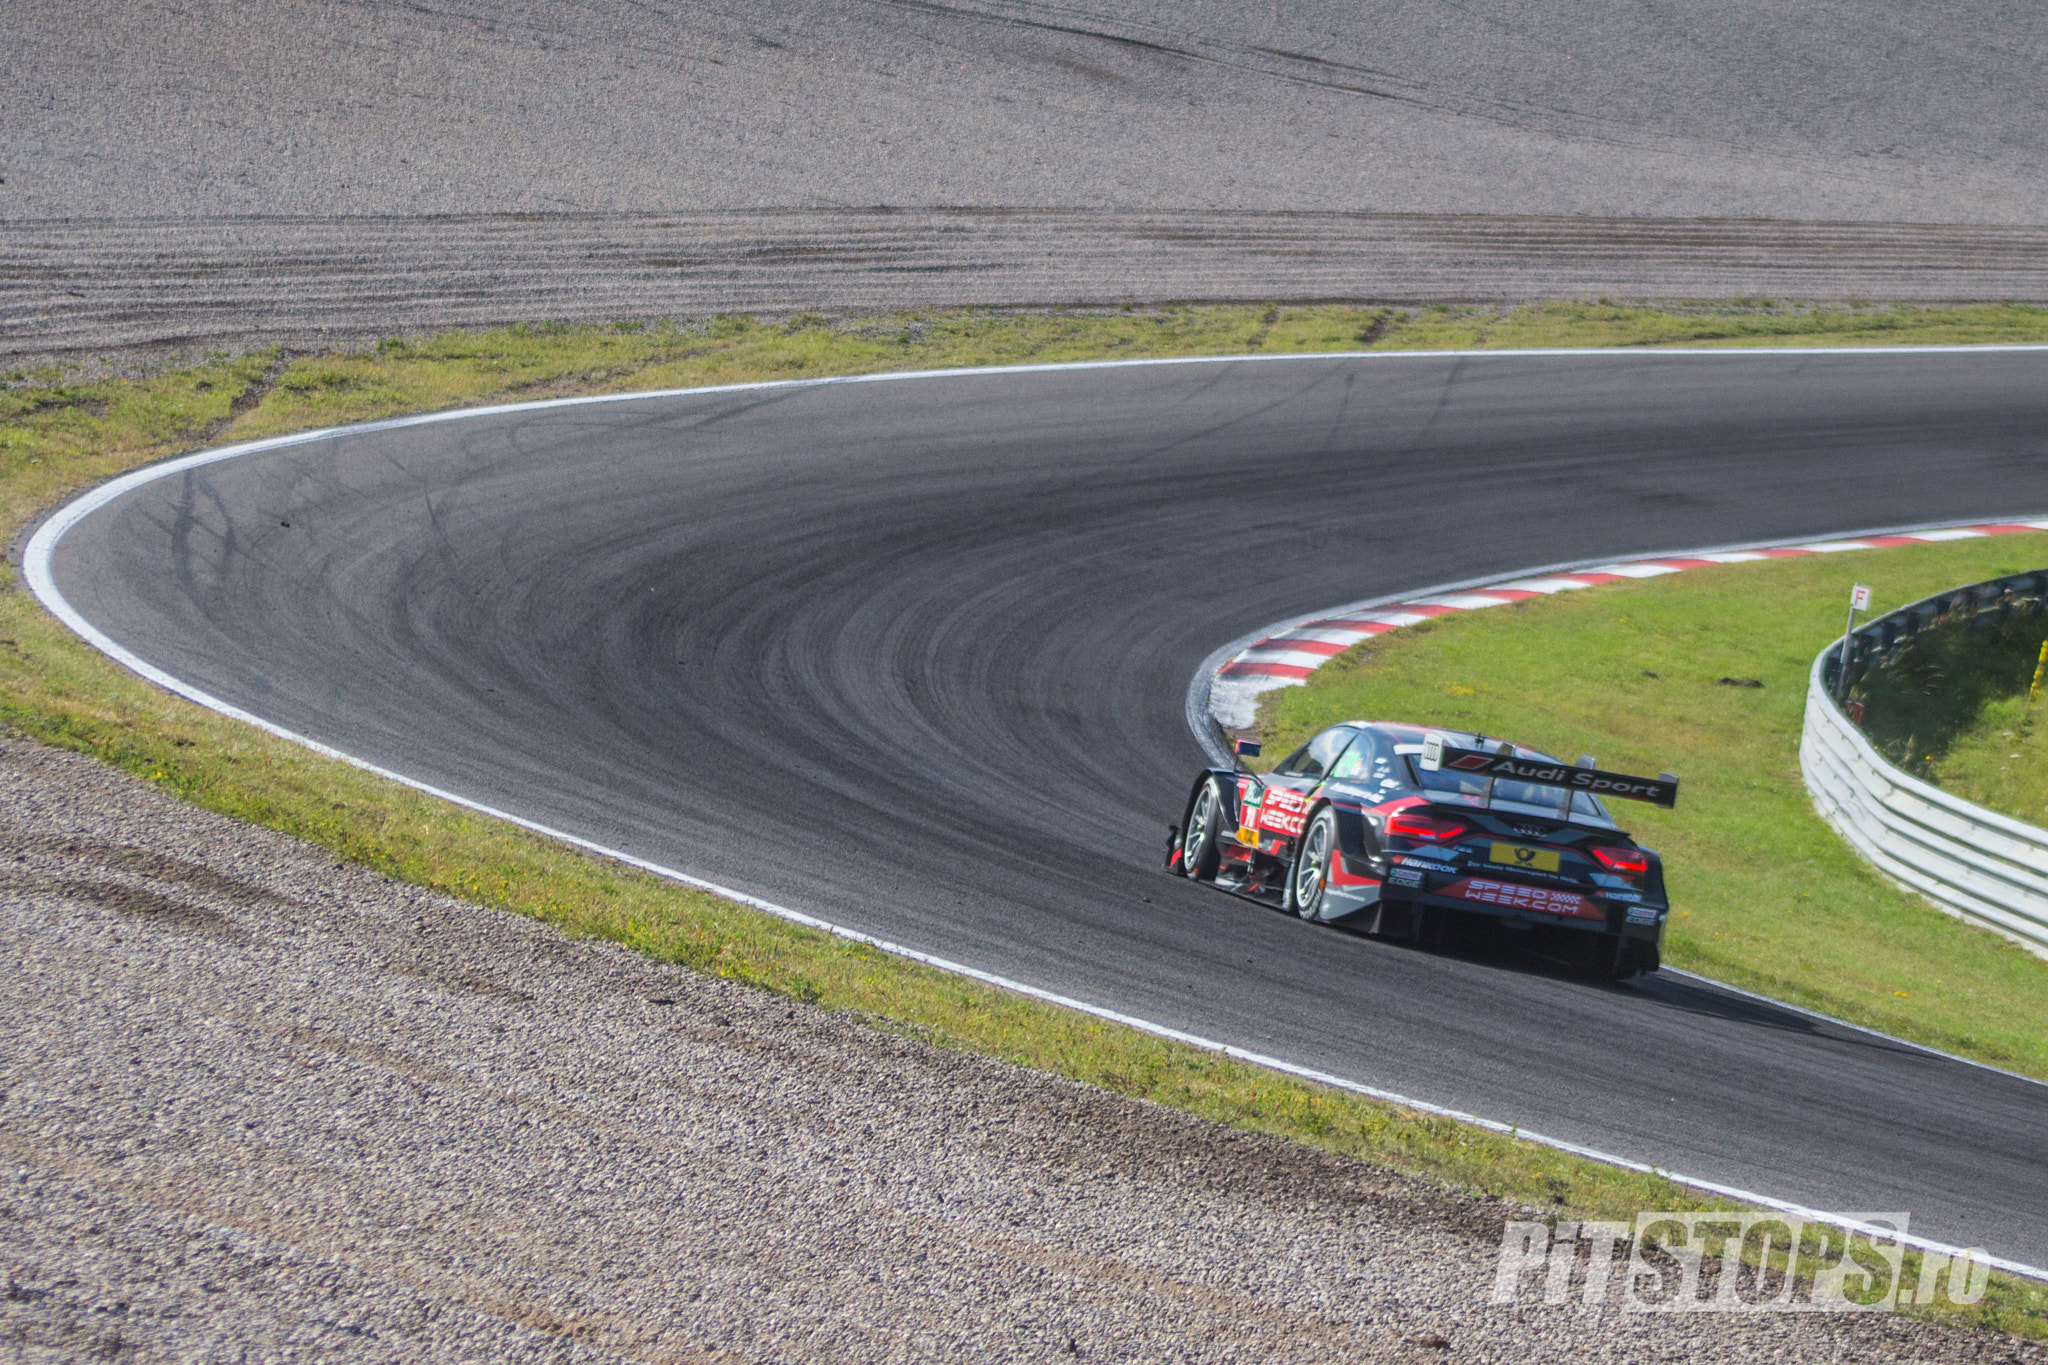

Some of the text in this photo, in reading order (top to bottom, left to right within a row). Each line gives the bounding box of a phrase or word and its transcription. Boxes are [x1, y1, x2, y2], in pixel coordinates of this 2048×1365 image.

[1854, 589, 1867, 606] F
[1492, 760, 1662, 797] Audi Sport
[1388, 876, 1422, 889] EDGE
[1467, 879, 1548, 900] SPEED
[1464, 889, 1579, 915] WEEK.COM
